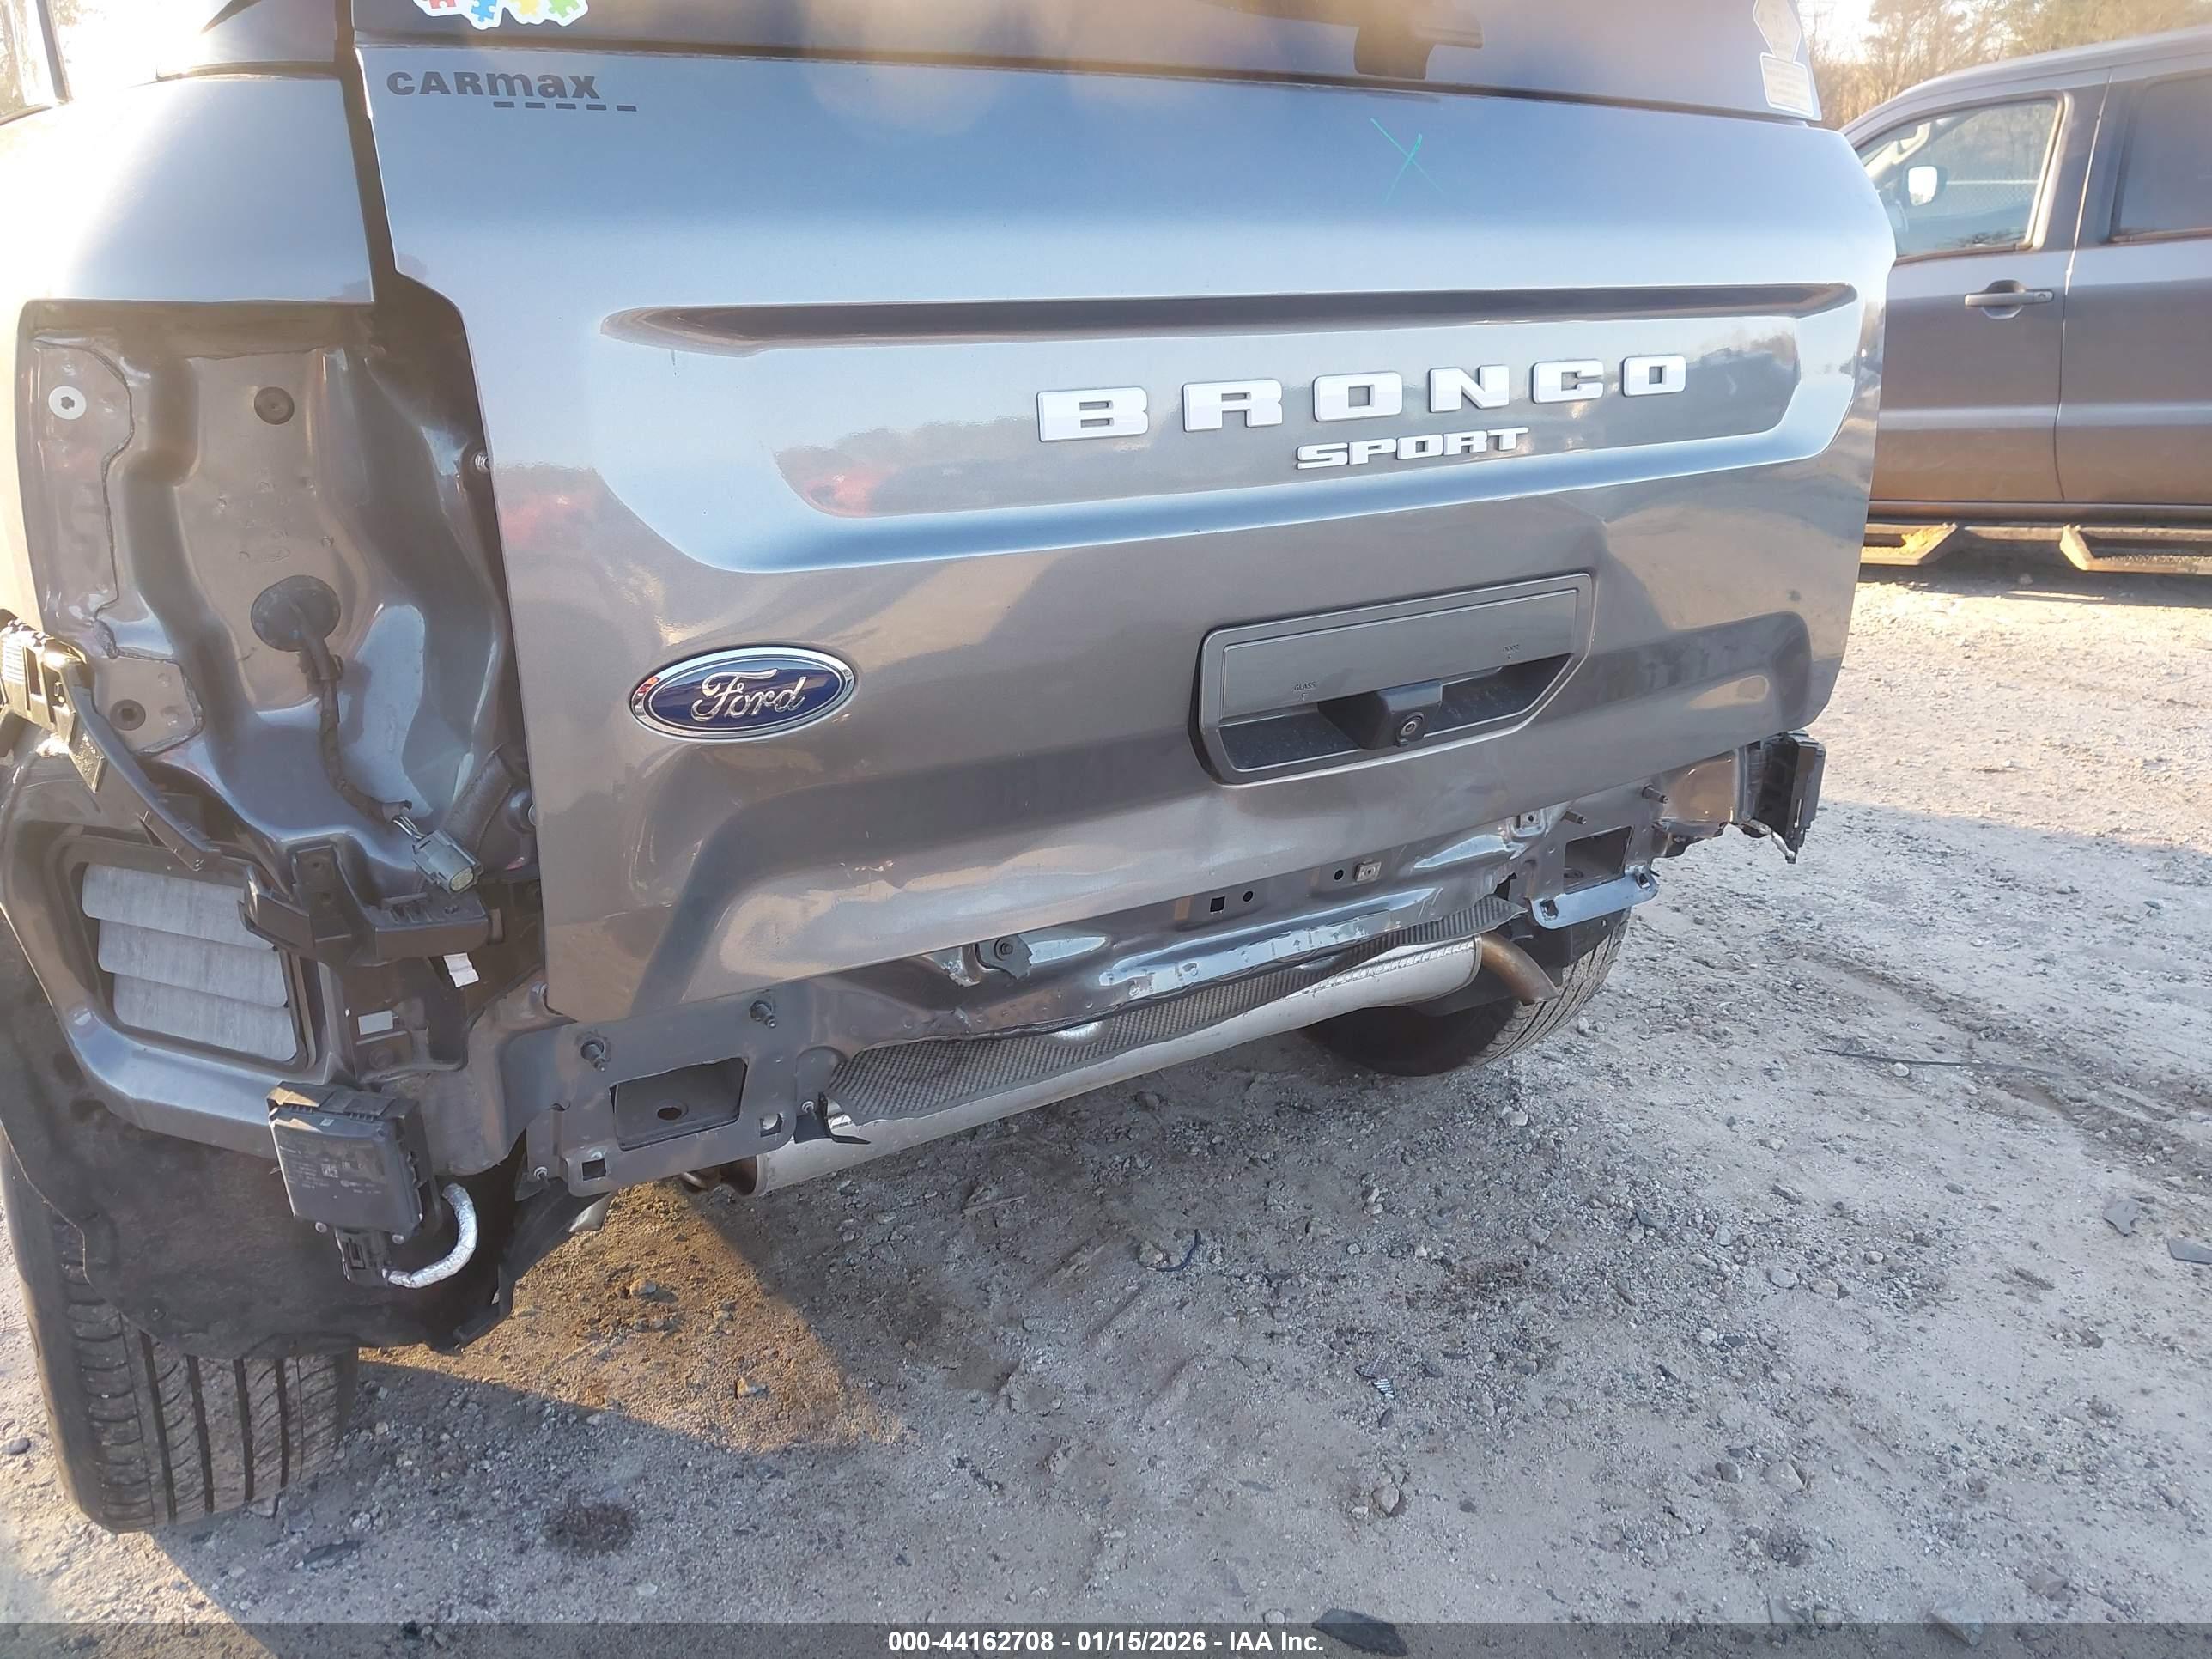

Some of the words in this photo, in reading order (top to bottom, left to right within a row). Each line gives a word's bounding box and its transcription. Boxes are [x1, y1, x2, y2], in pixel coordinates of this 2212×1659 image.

[1037, 354, 1686, 443] BRONCO
[1295, 426, 1529, 470] SPORT
[690, 668, 807, 721] Ford
